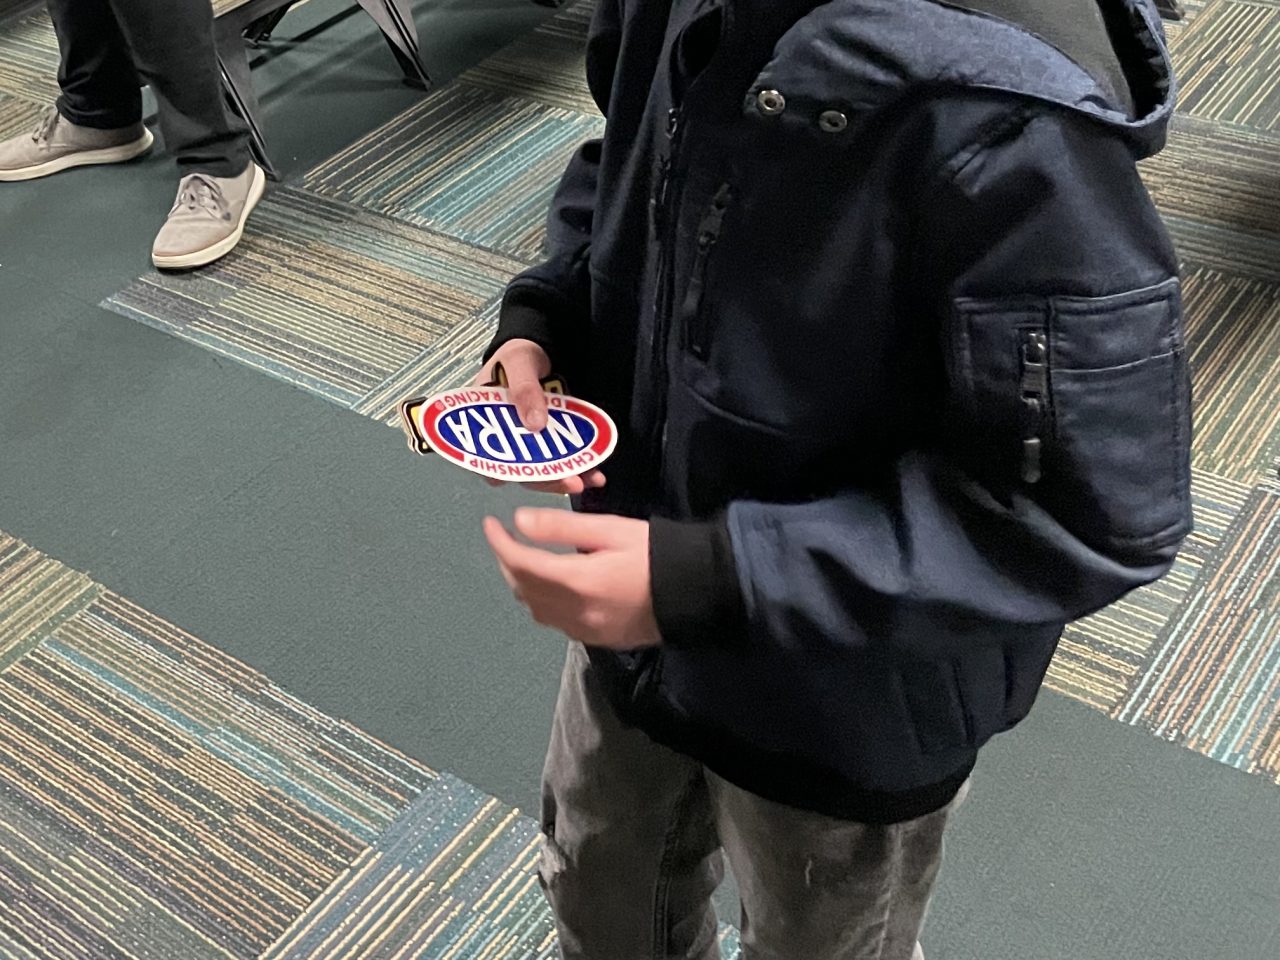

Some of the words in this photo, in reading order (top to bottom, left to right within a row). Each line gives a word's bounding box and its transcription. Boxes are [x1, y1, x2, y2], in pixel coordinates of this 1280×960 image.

[443, 391, 503, 407] RACING
[445, 406, 585, 461] NHRA
[469, 451, 595, 476] CHAMPIONSHIP
